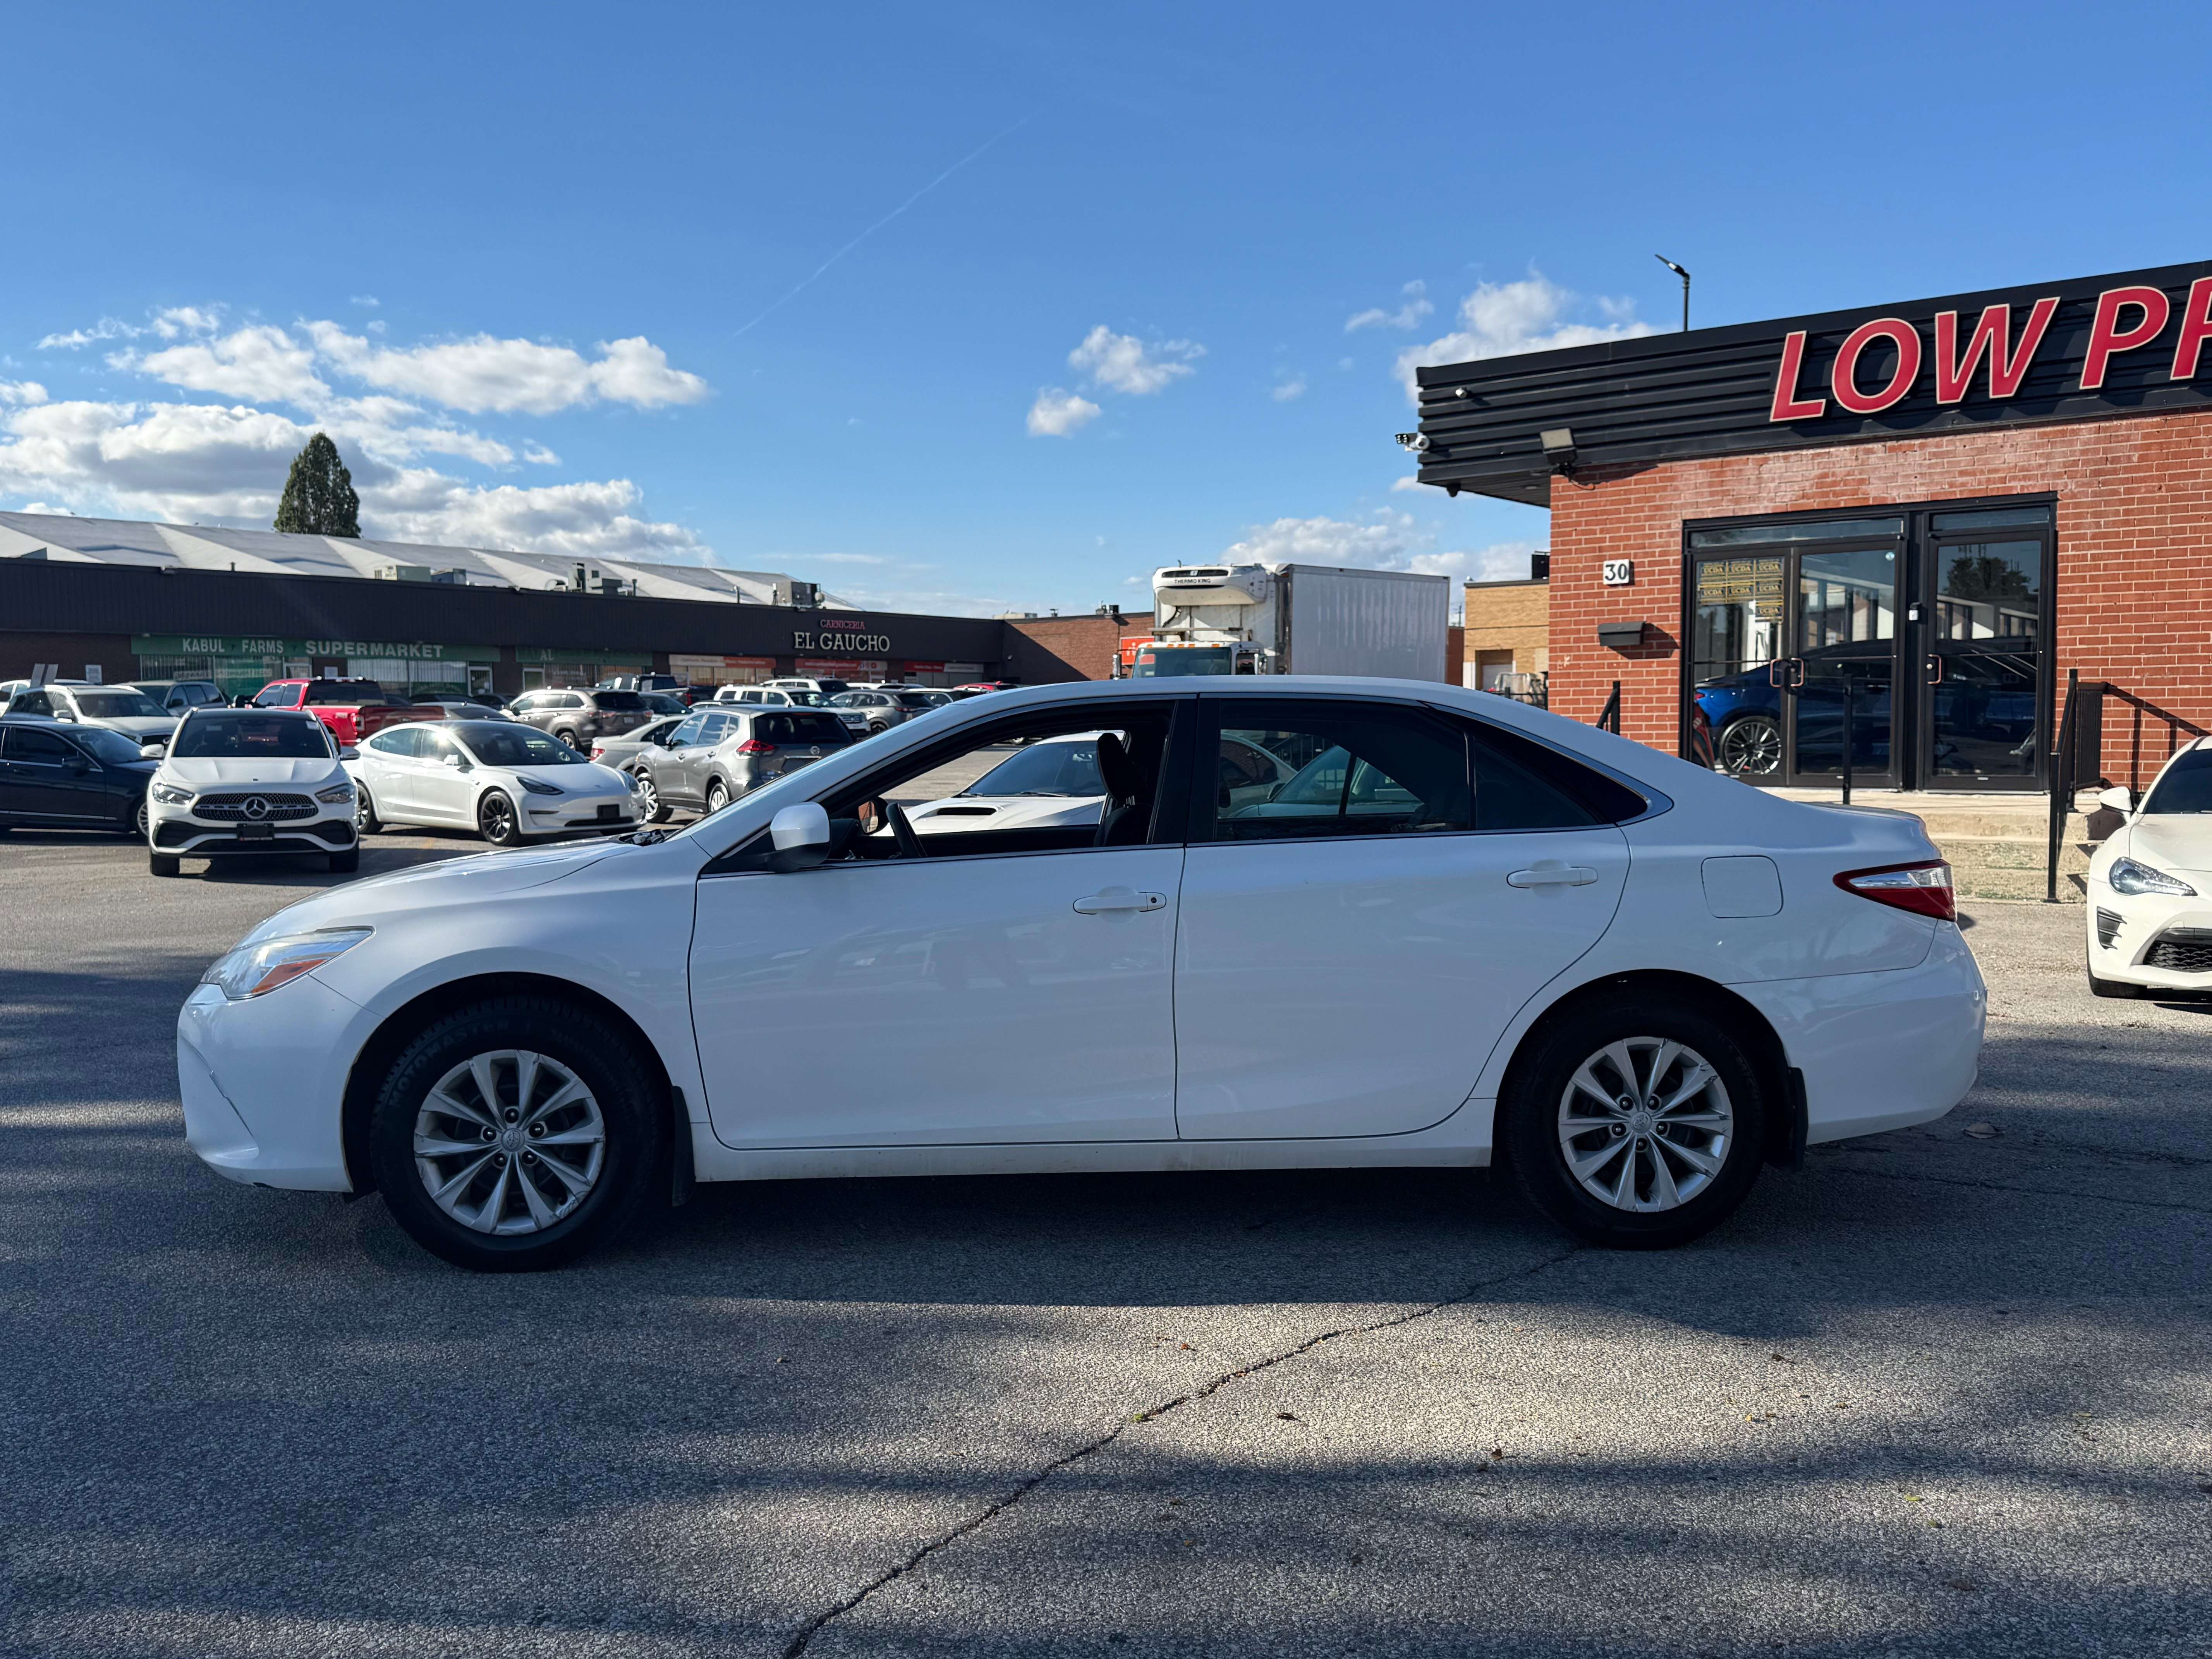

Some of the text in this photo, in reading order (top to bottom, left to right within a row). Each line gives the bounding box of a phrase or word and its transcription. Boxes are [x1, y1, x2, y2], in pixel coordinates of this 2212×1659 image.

[1769, 296, 2061, 423] LOW
[1605, 563, 1628, 581] 30
[820, 619, 866, 630] CARNICERIA
[182, 638, 443, 658] KABUL FARMS SUPERMARKET
[794, 632, 890, 652] EL GAUCHO
